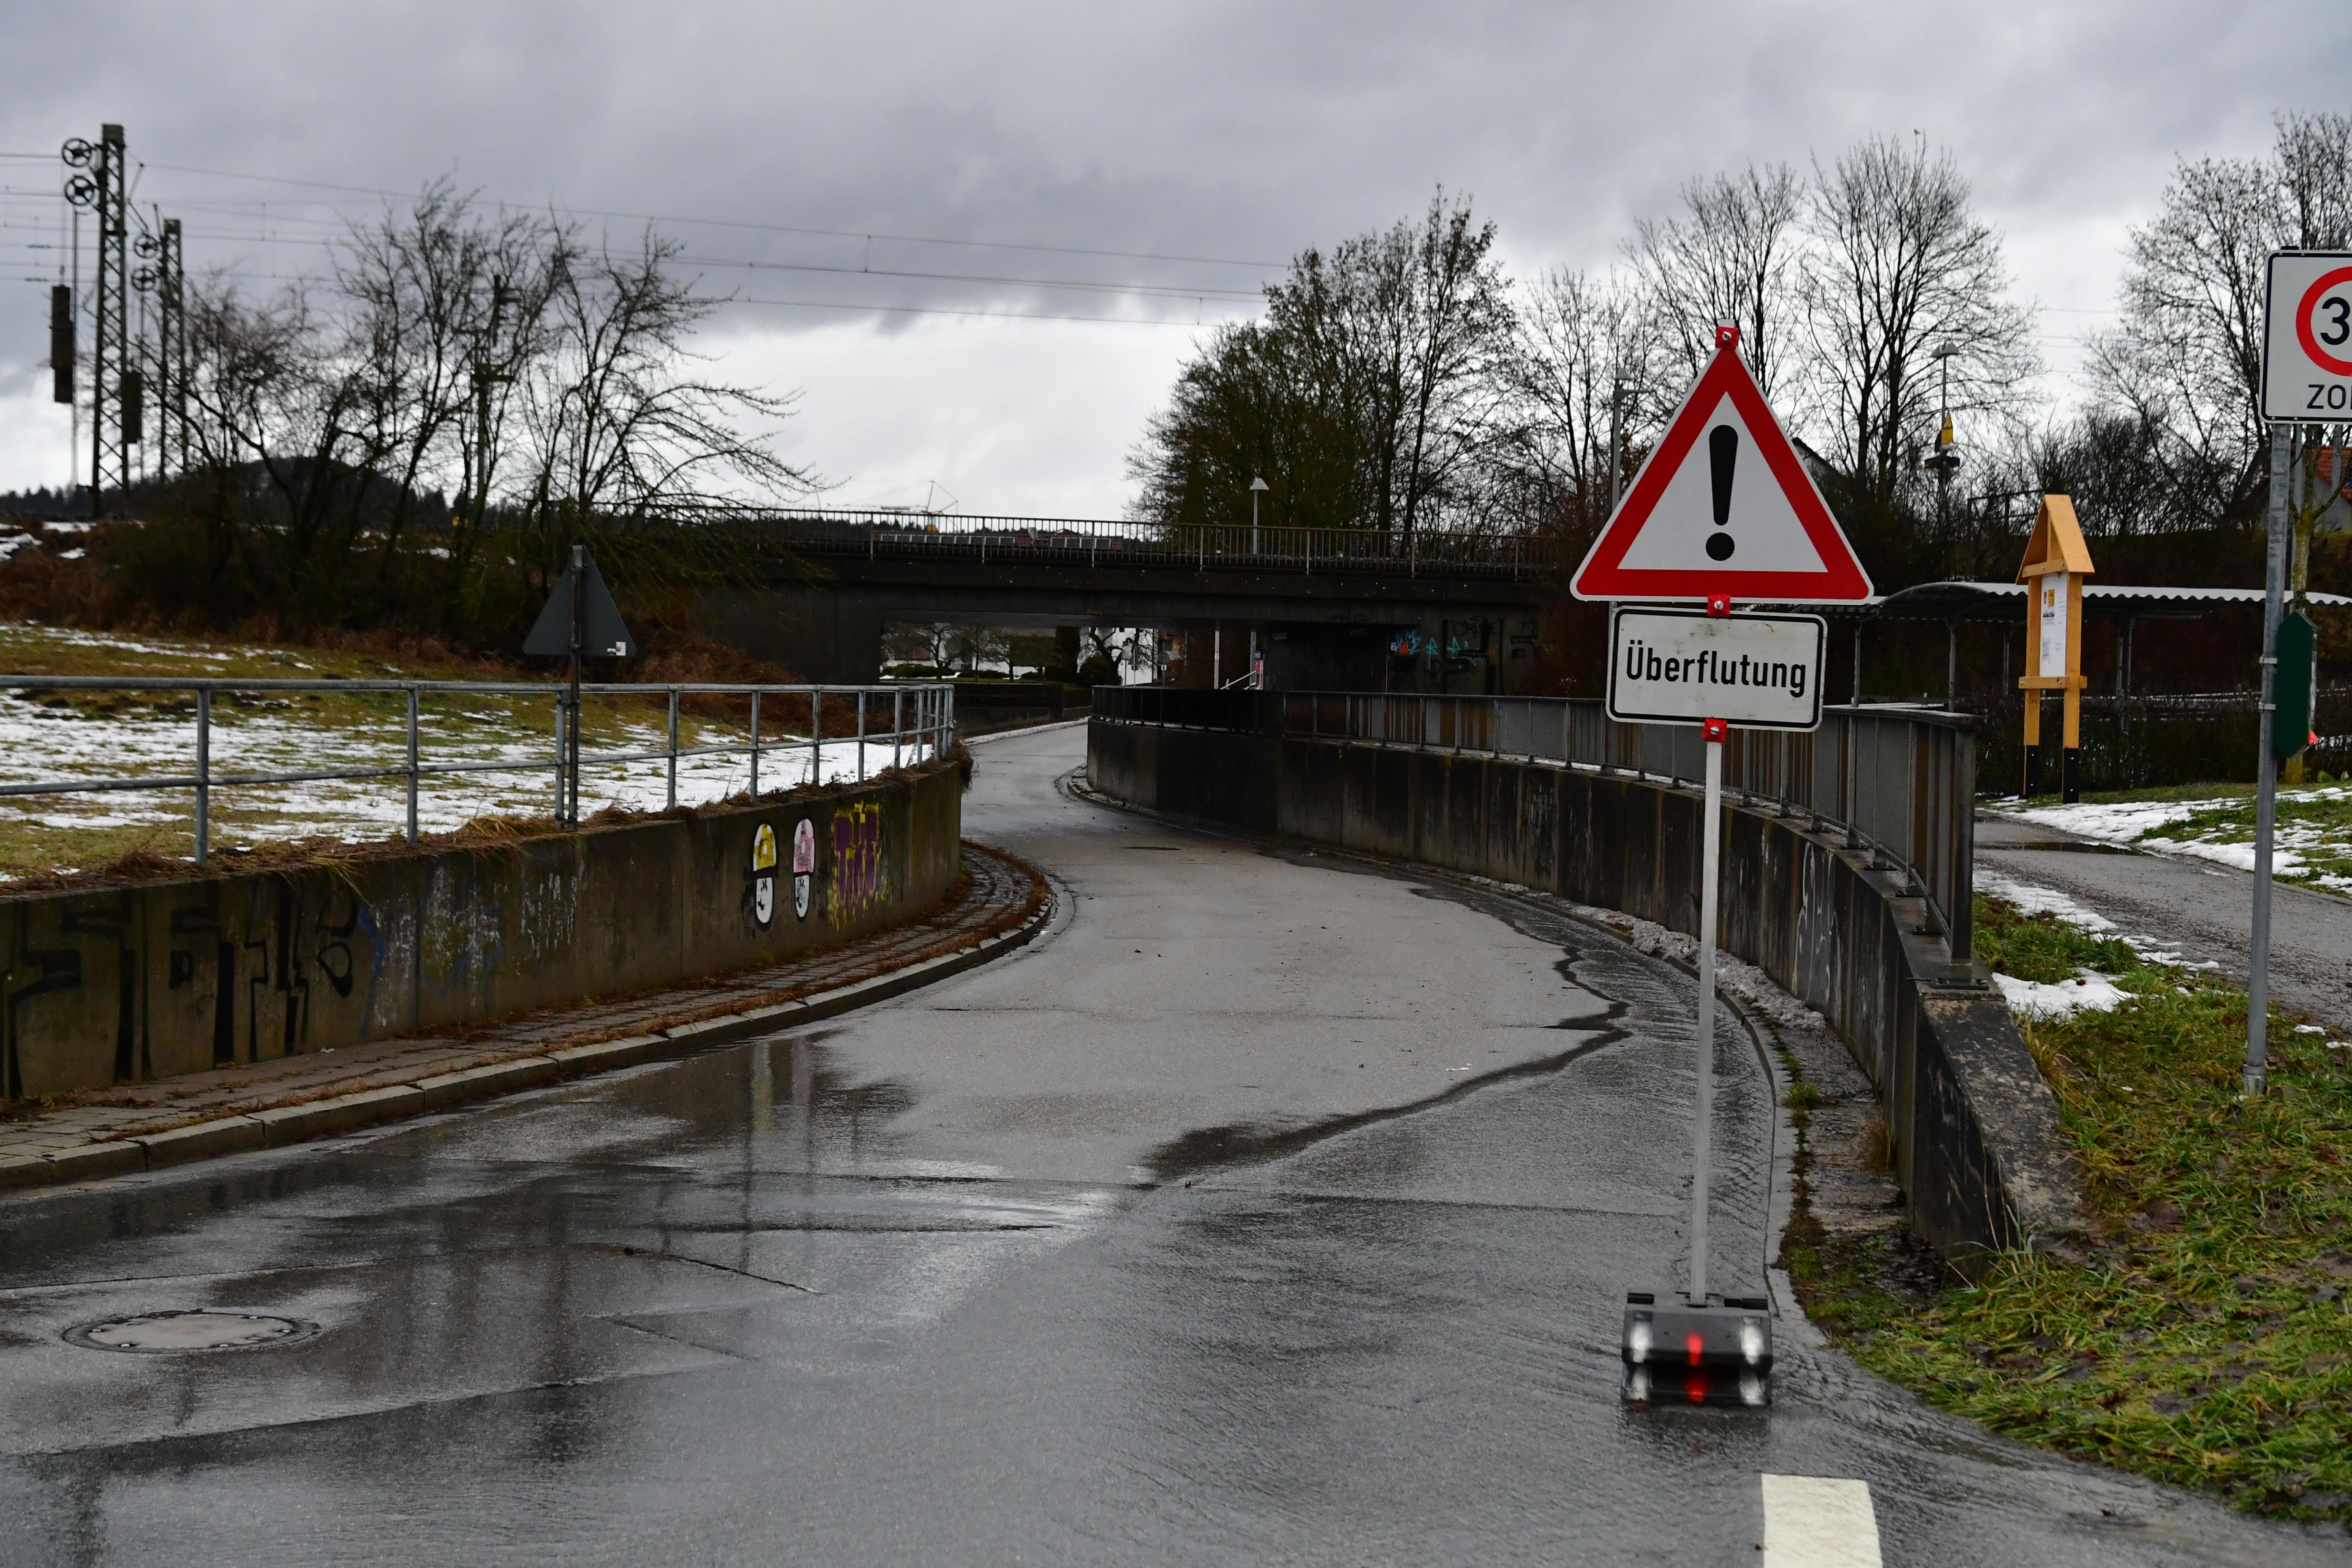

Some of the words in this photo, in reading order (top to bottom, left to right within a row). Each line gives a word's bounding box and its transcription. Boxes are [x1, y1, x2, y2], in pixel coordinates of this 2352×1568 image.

[2320, 297, 2351, 346] 3
[2306, 384, 2352, 410] ZO
[1626, 639, 1806, 698] Überflutung
